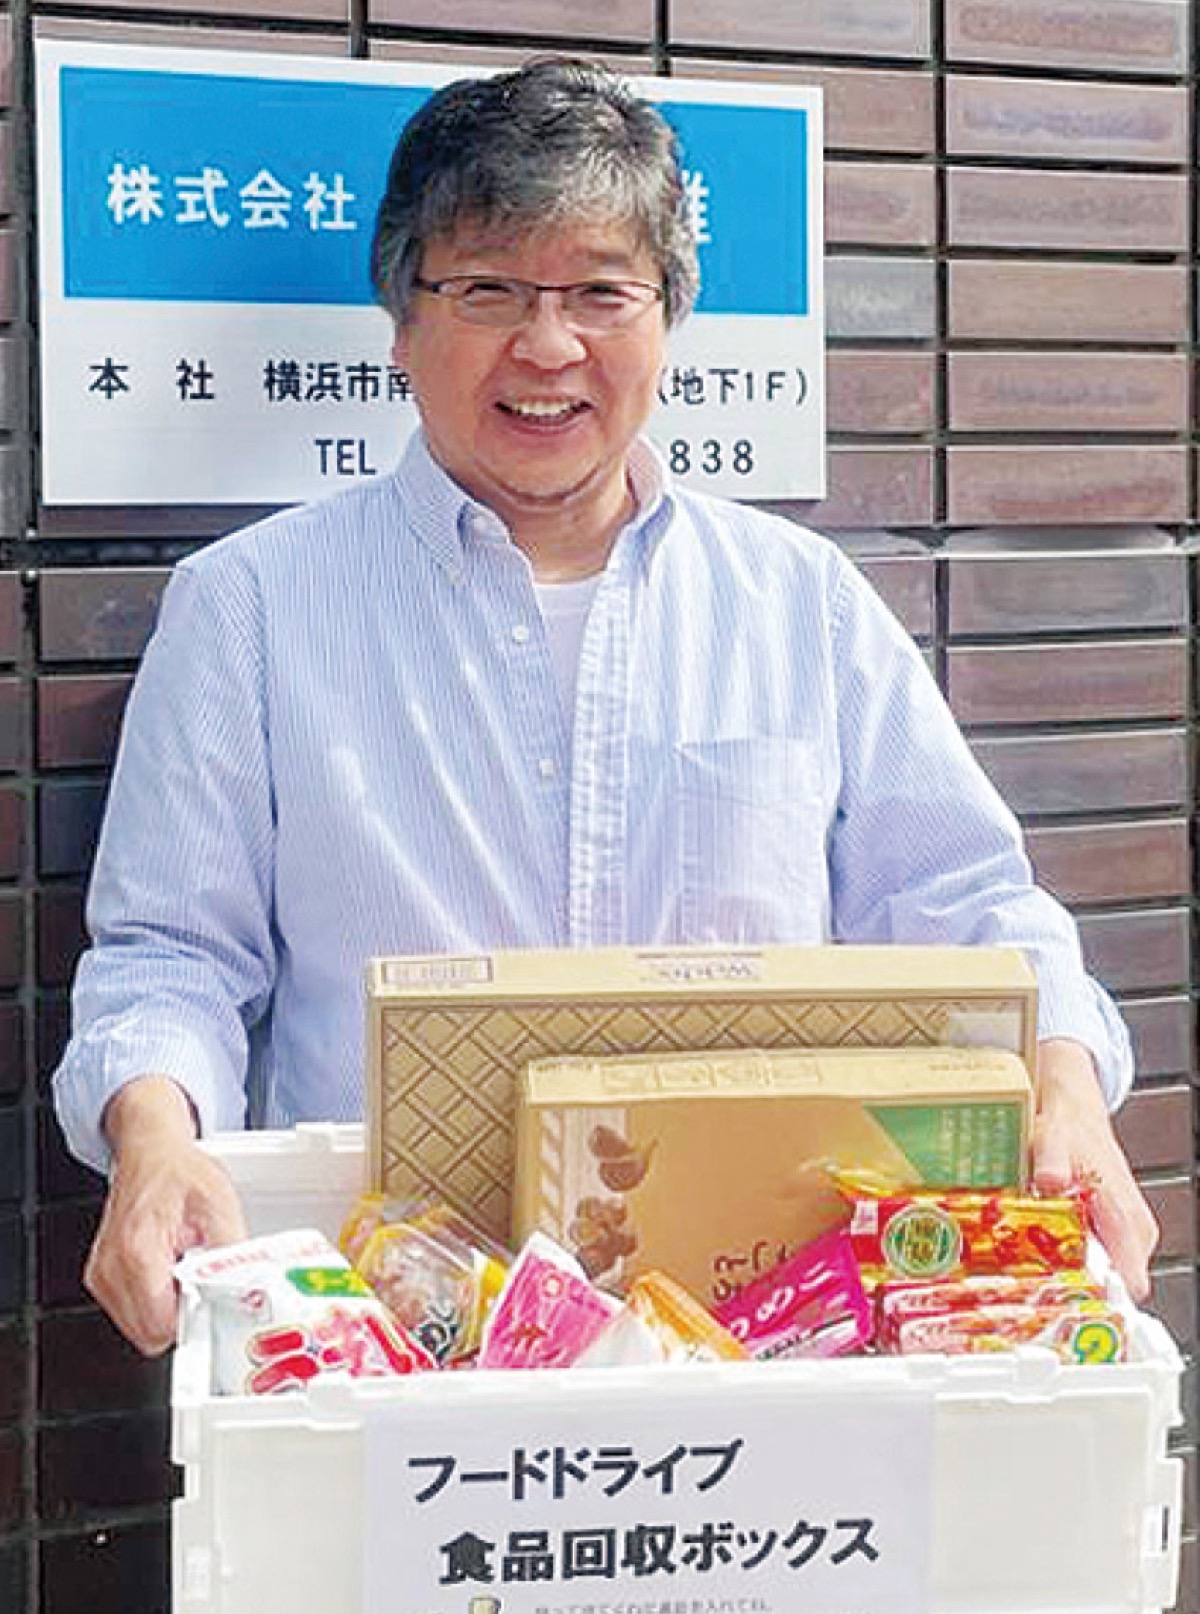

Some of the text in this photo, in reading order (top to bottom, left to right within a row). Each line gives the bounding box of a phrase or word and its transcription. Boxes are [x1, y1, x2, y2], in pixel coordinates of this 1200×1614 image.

[107, 162, 358, 231] 株式会社
[315, 438, 756, 477] TEL 838
[408, 1438, 744, 1502] フードドライブ
[438, 1518, 880, 1586] 食品回収ボックス
